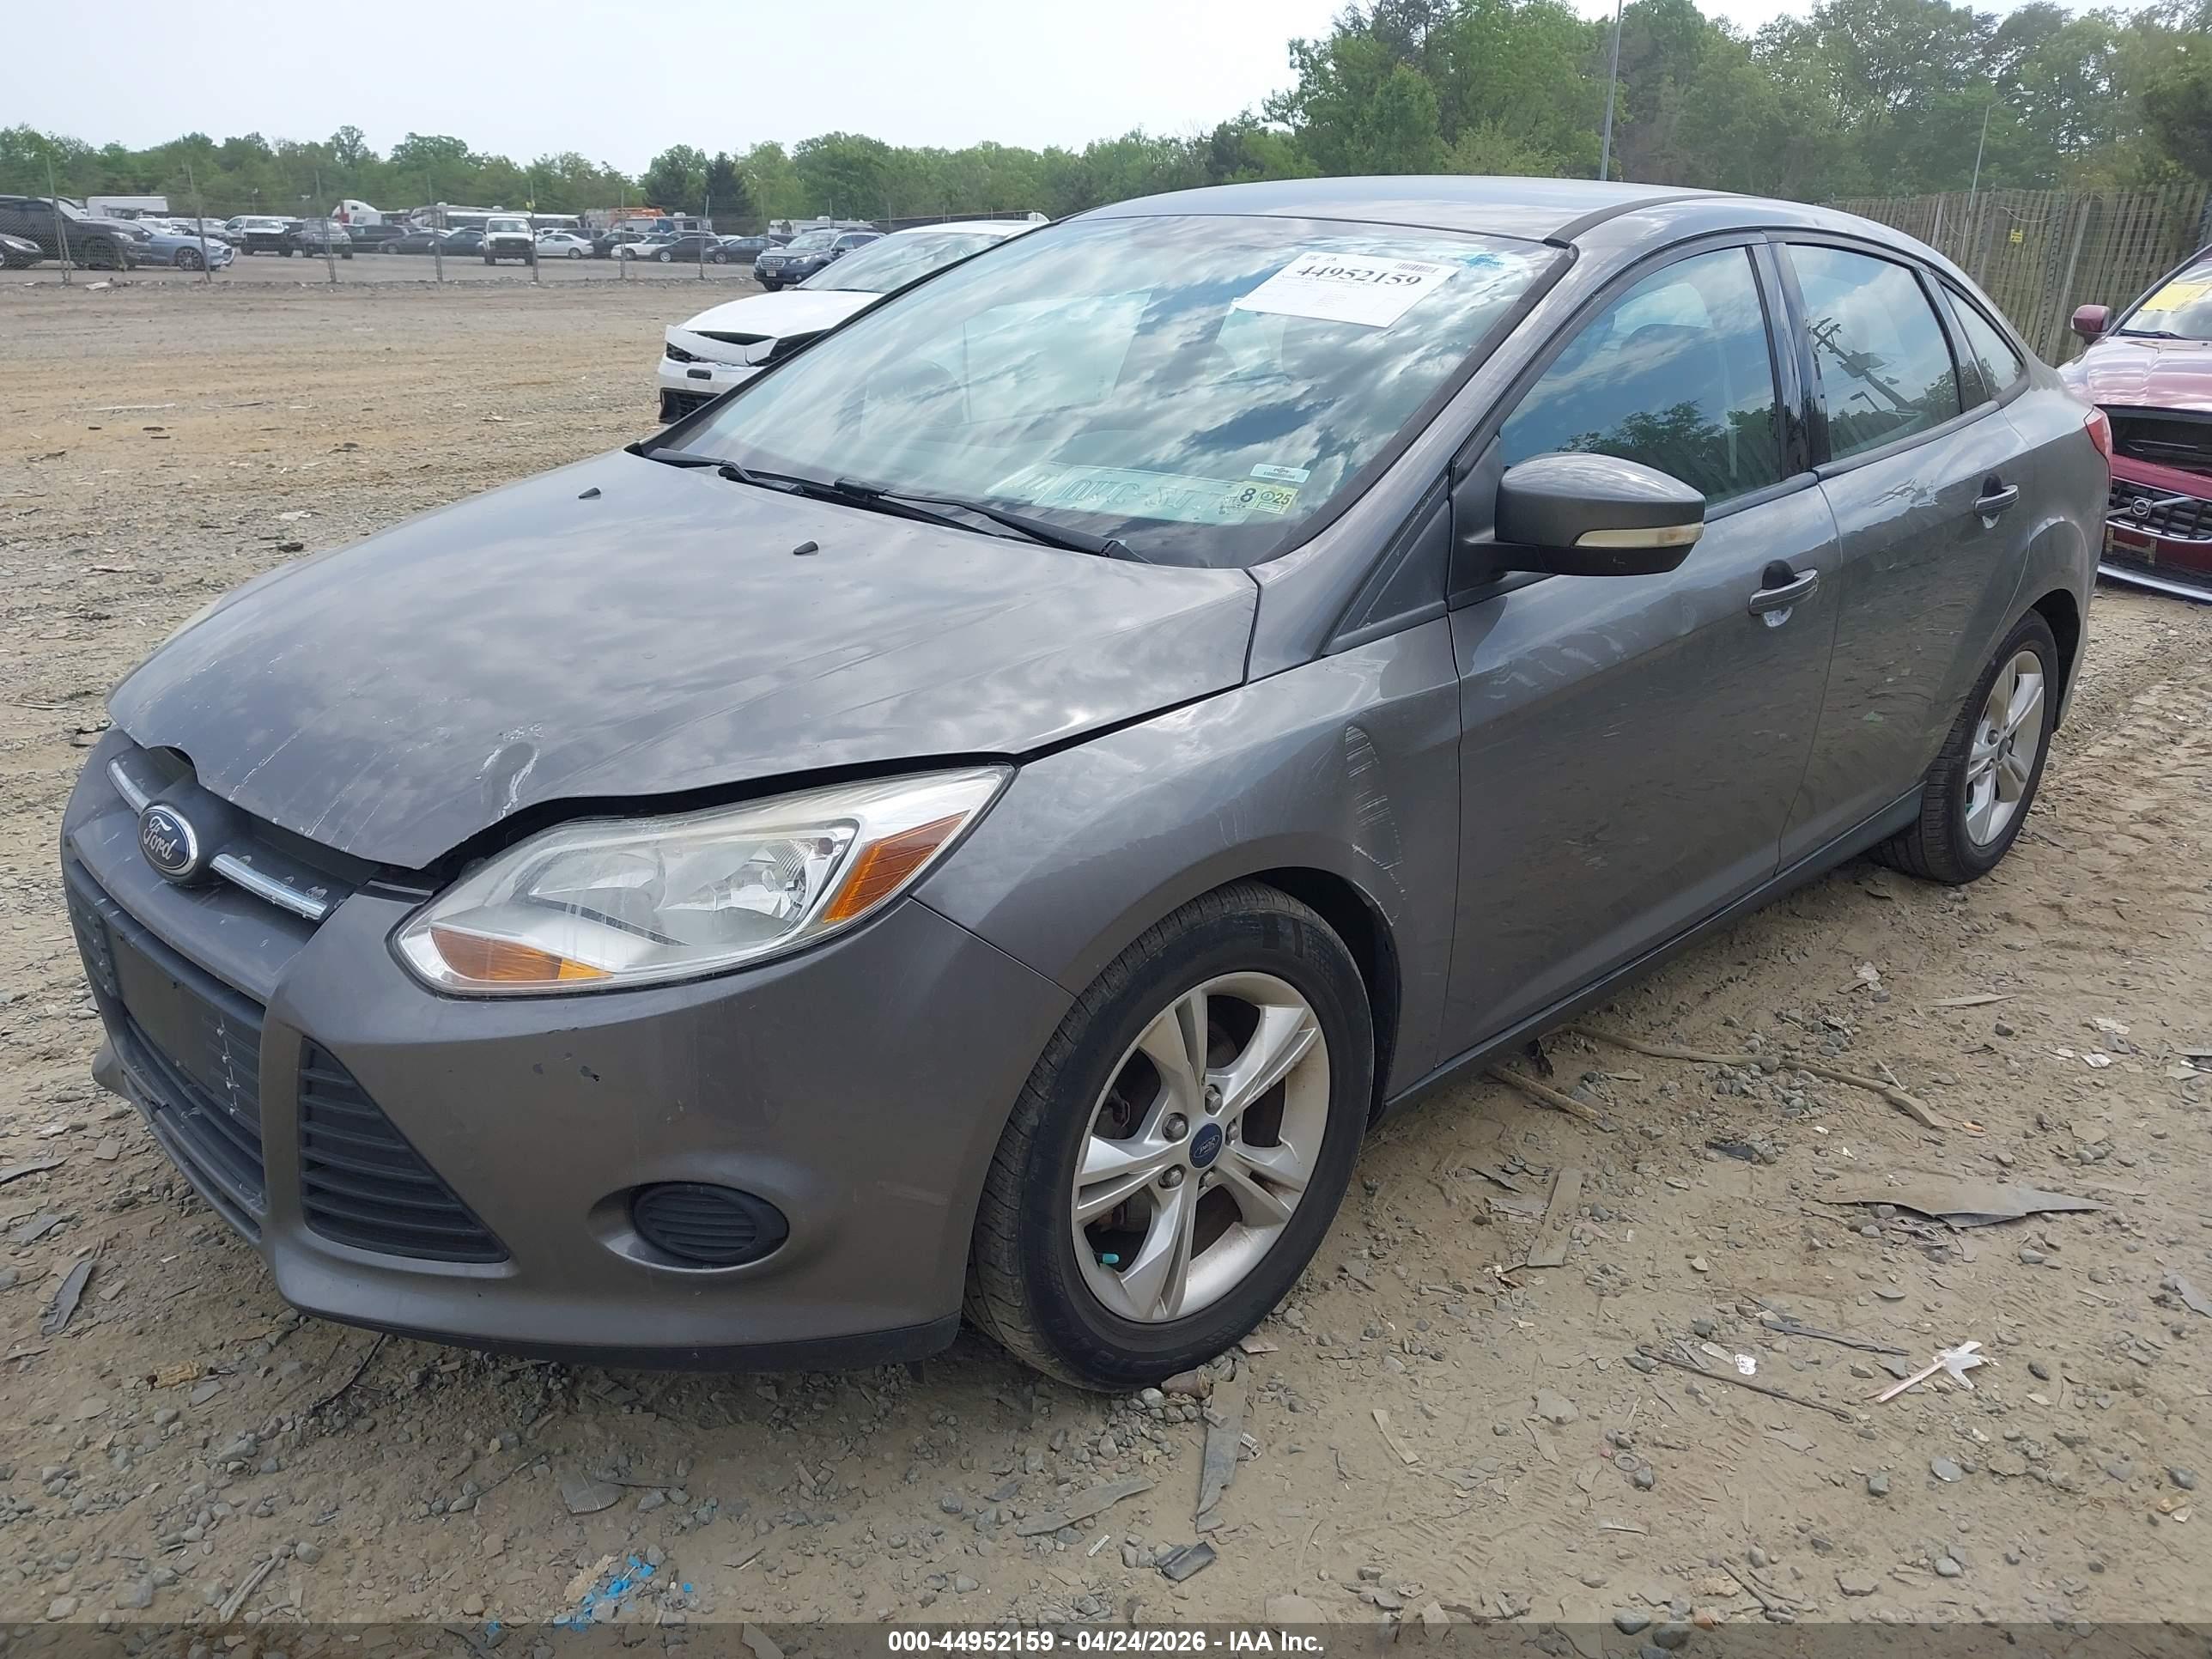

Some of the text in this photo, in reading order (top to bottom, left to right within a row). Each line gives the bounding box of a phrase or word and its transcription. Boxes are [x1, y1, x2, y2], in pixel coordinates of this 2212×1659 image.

[1297, 264, 1422, 287] 44952159
[1240, 487, 1292, 505] 8 25
[143, 816, 178, 860] Ford
